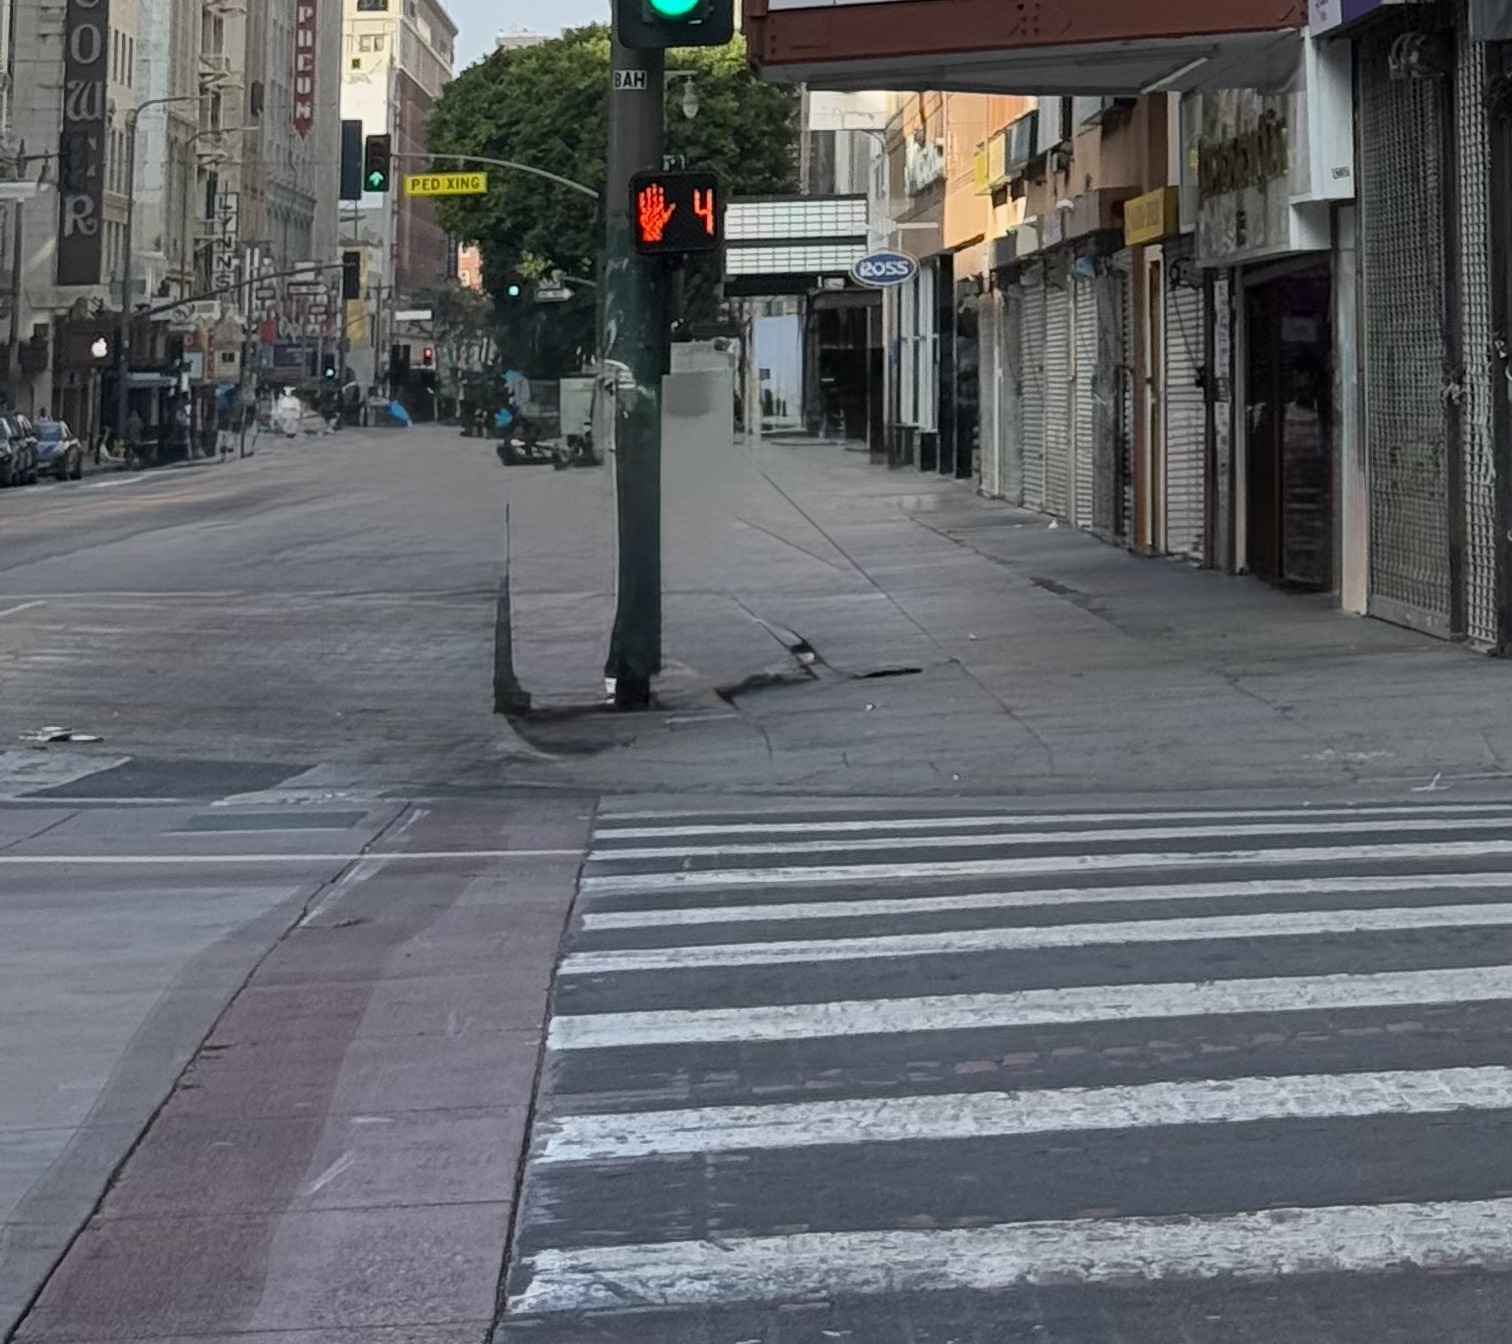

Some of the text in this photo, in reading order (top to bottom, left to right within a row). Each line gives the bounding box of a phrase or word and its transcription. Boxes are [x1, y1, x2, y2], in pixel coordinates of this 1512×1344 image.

[614, 71, 646, 89] BAH
[410, 175, 481, 192] PED XING
[693, 188, 715, 236] 4
[860, 260, 909, 277] ROSS
